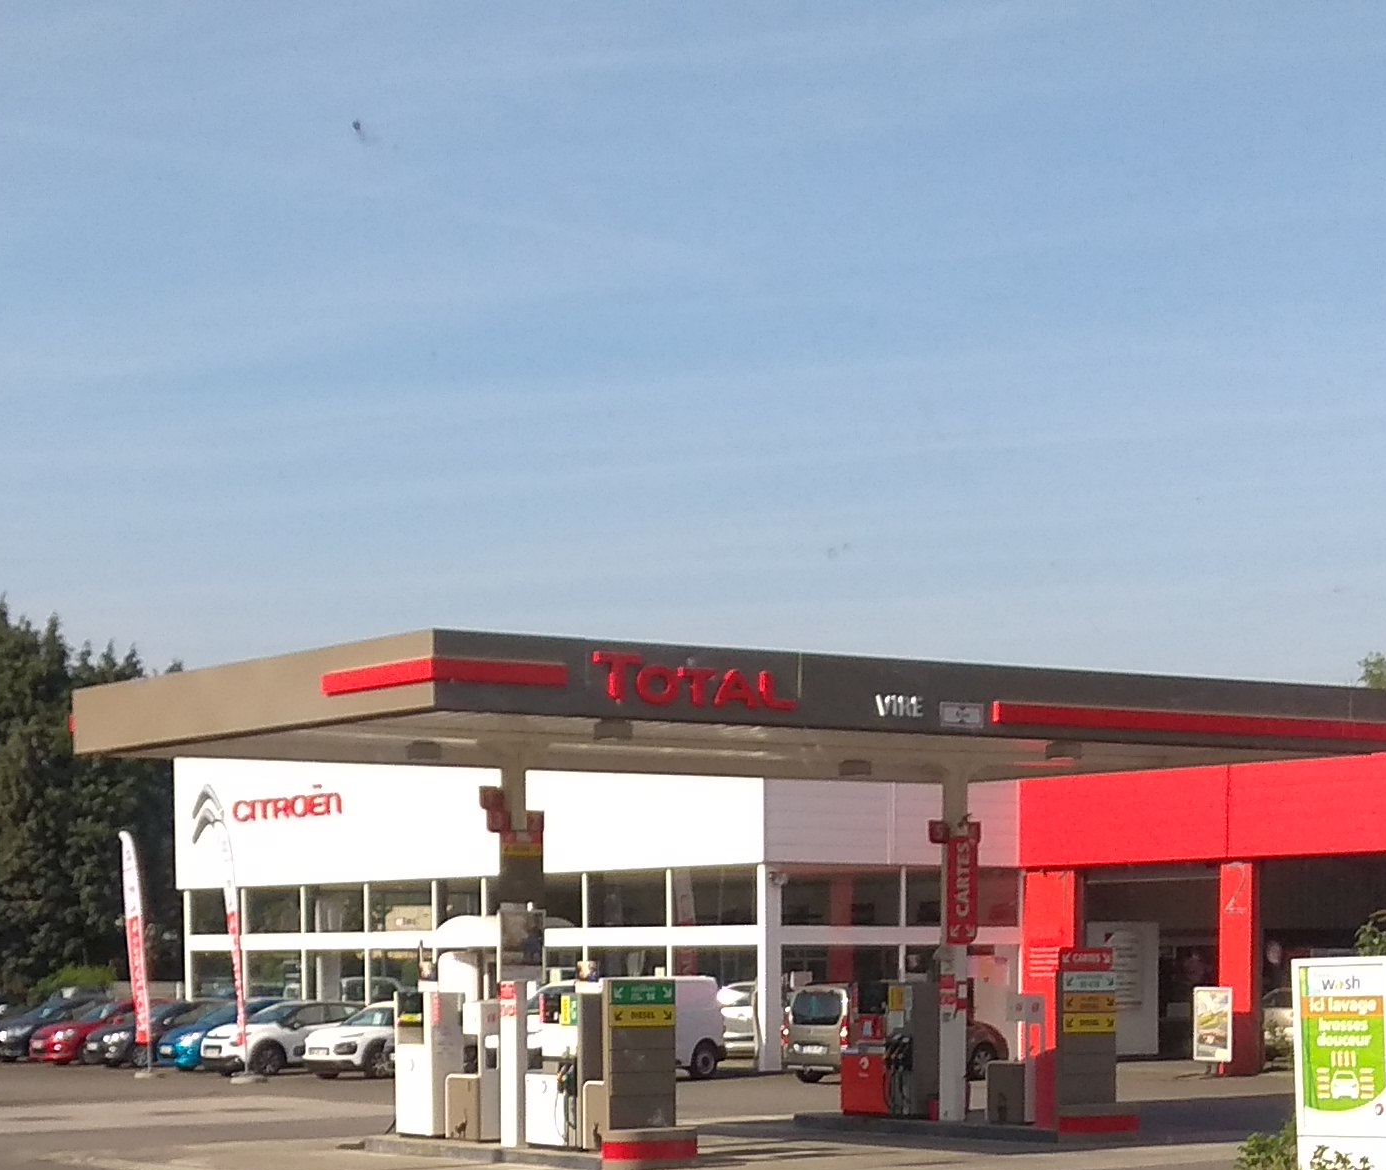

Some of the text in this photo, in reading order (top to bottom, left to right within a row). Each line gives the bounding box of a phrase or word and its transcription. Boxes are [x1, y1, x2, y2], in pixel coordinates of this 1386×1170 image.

[591, 650, 797, 712] TOTAL
[1309, 996, 1377, 1015] ici lavage
[1319, 1017, 1369, 1032] brosses
[1317, 1032, 1372, 1047] douceur
